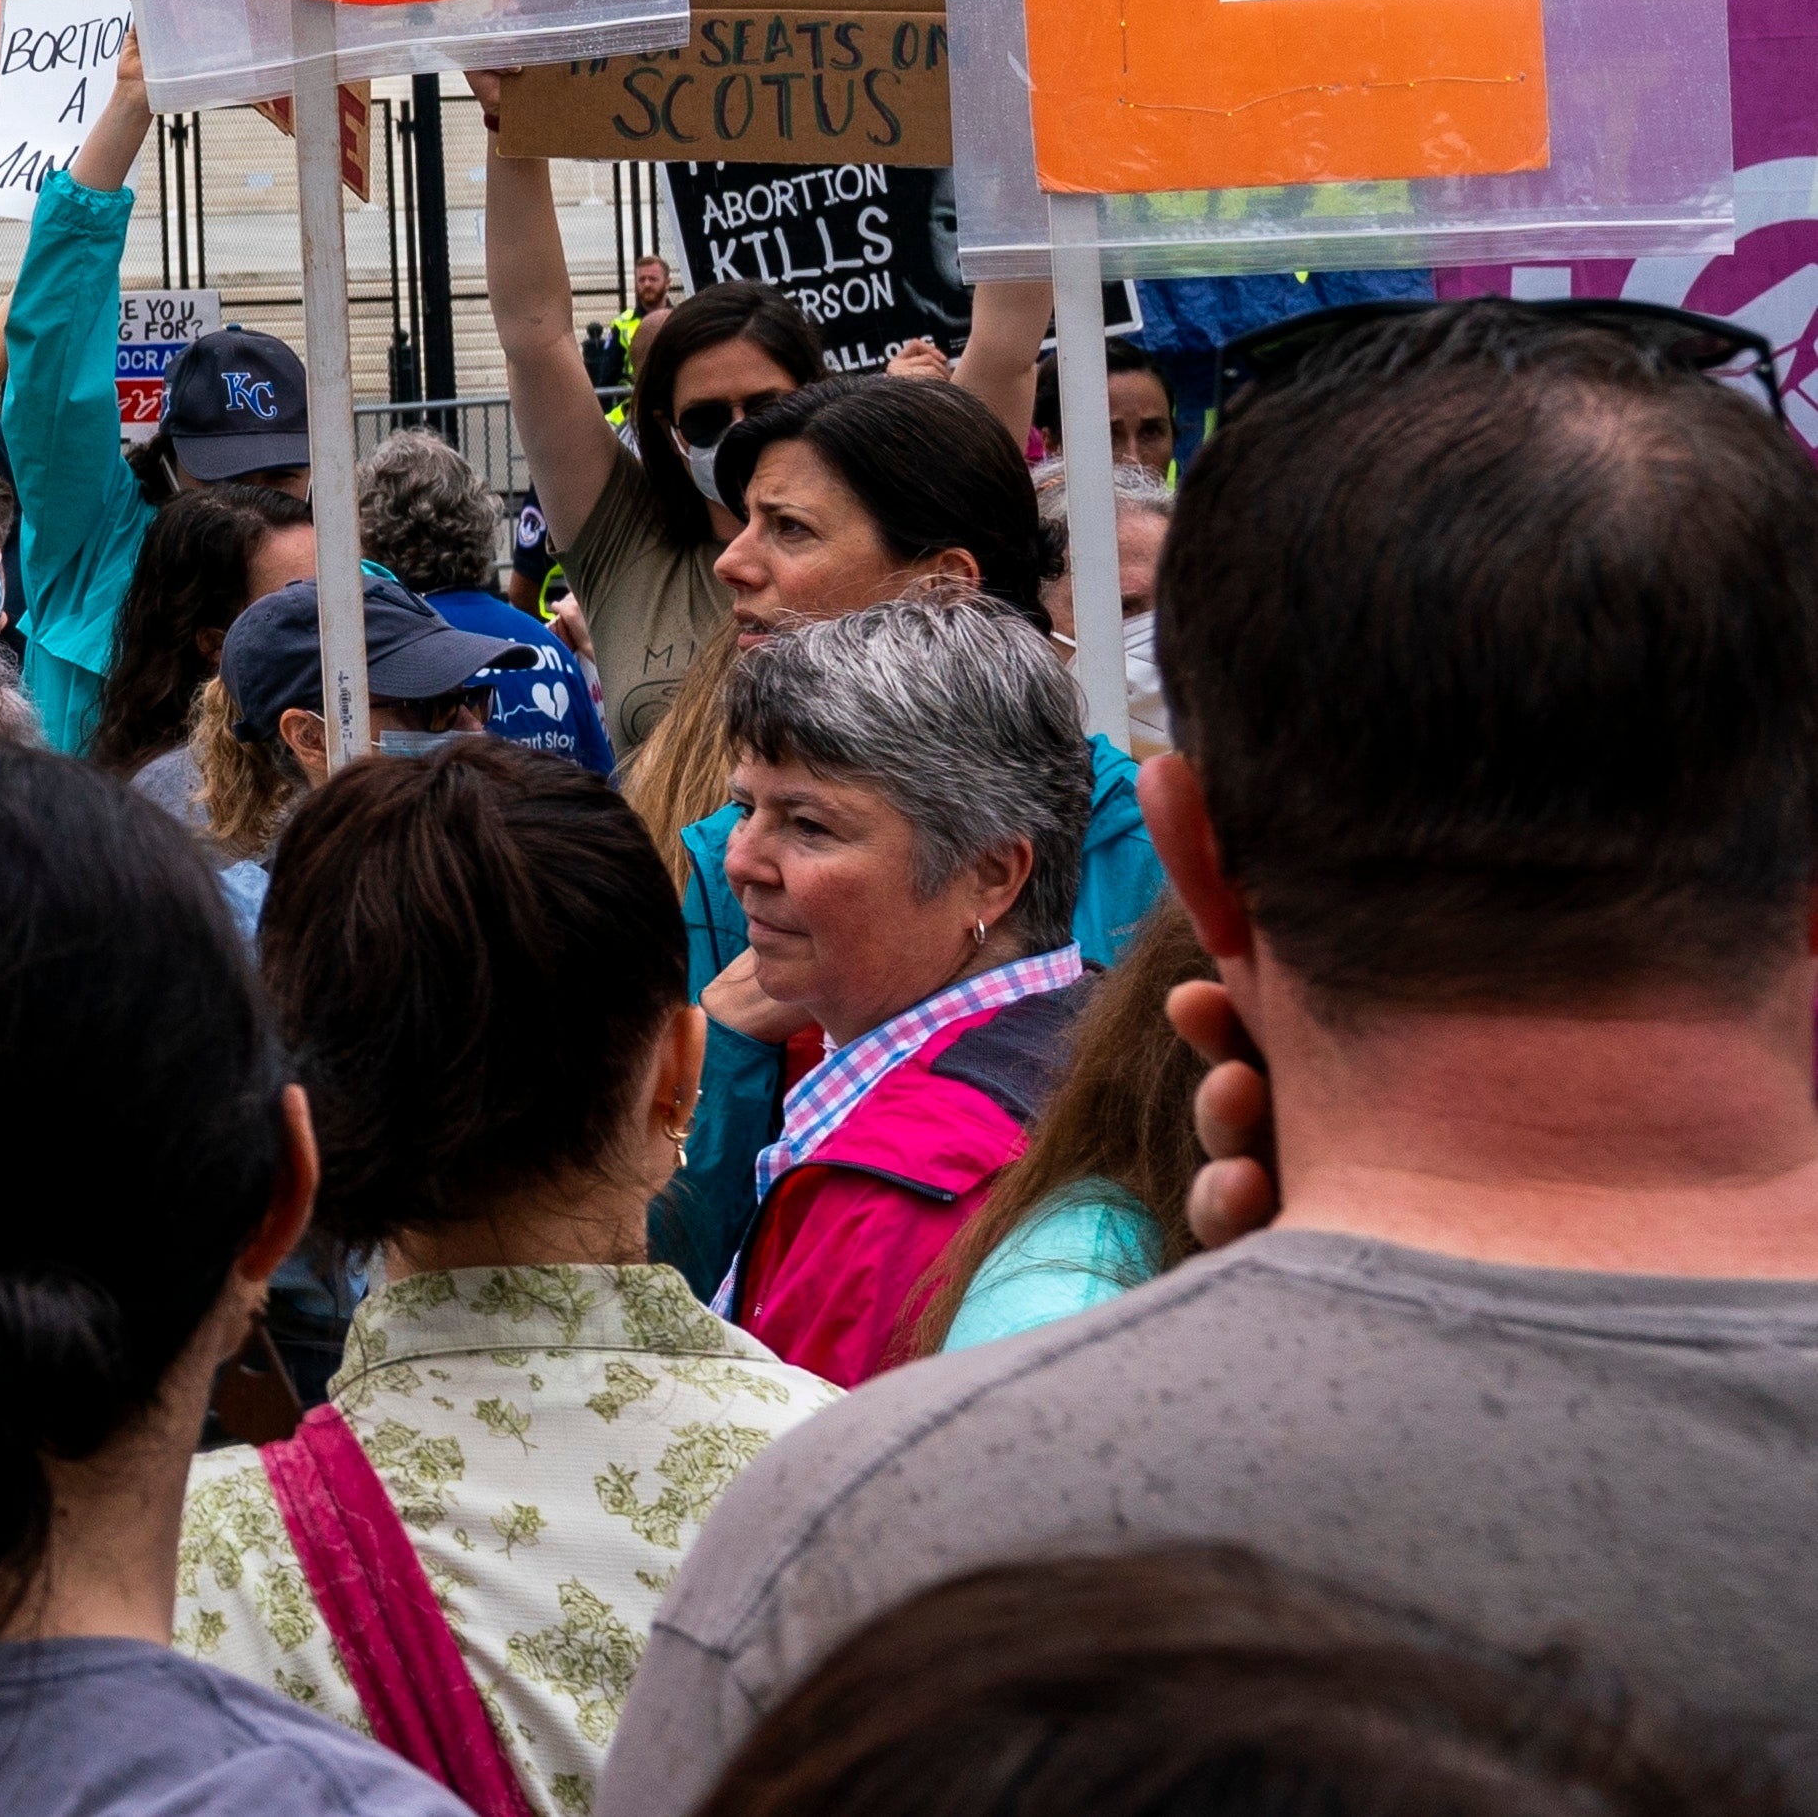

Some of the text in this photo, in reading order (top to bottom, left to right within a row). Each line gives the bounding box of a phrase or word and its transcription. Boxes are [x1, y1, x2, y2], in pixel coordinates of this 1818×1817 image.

[699, 15, 865, 71] SEATS
[58, 77, 88, 123] A
[611, 66, 903, 148] SCOTUS
[702, 163, 888, 235] ABORTION
[710, 205, 893, 285] KILLS
[144, 318, 204, 342] FOR?
[145, 298, 195, 325] YOU
[221, 372, 278, 421] KC
